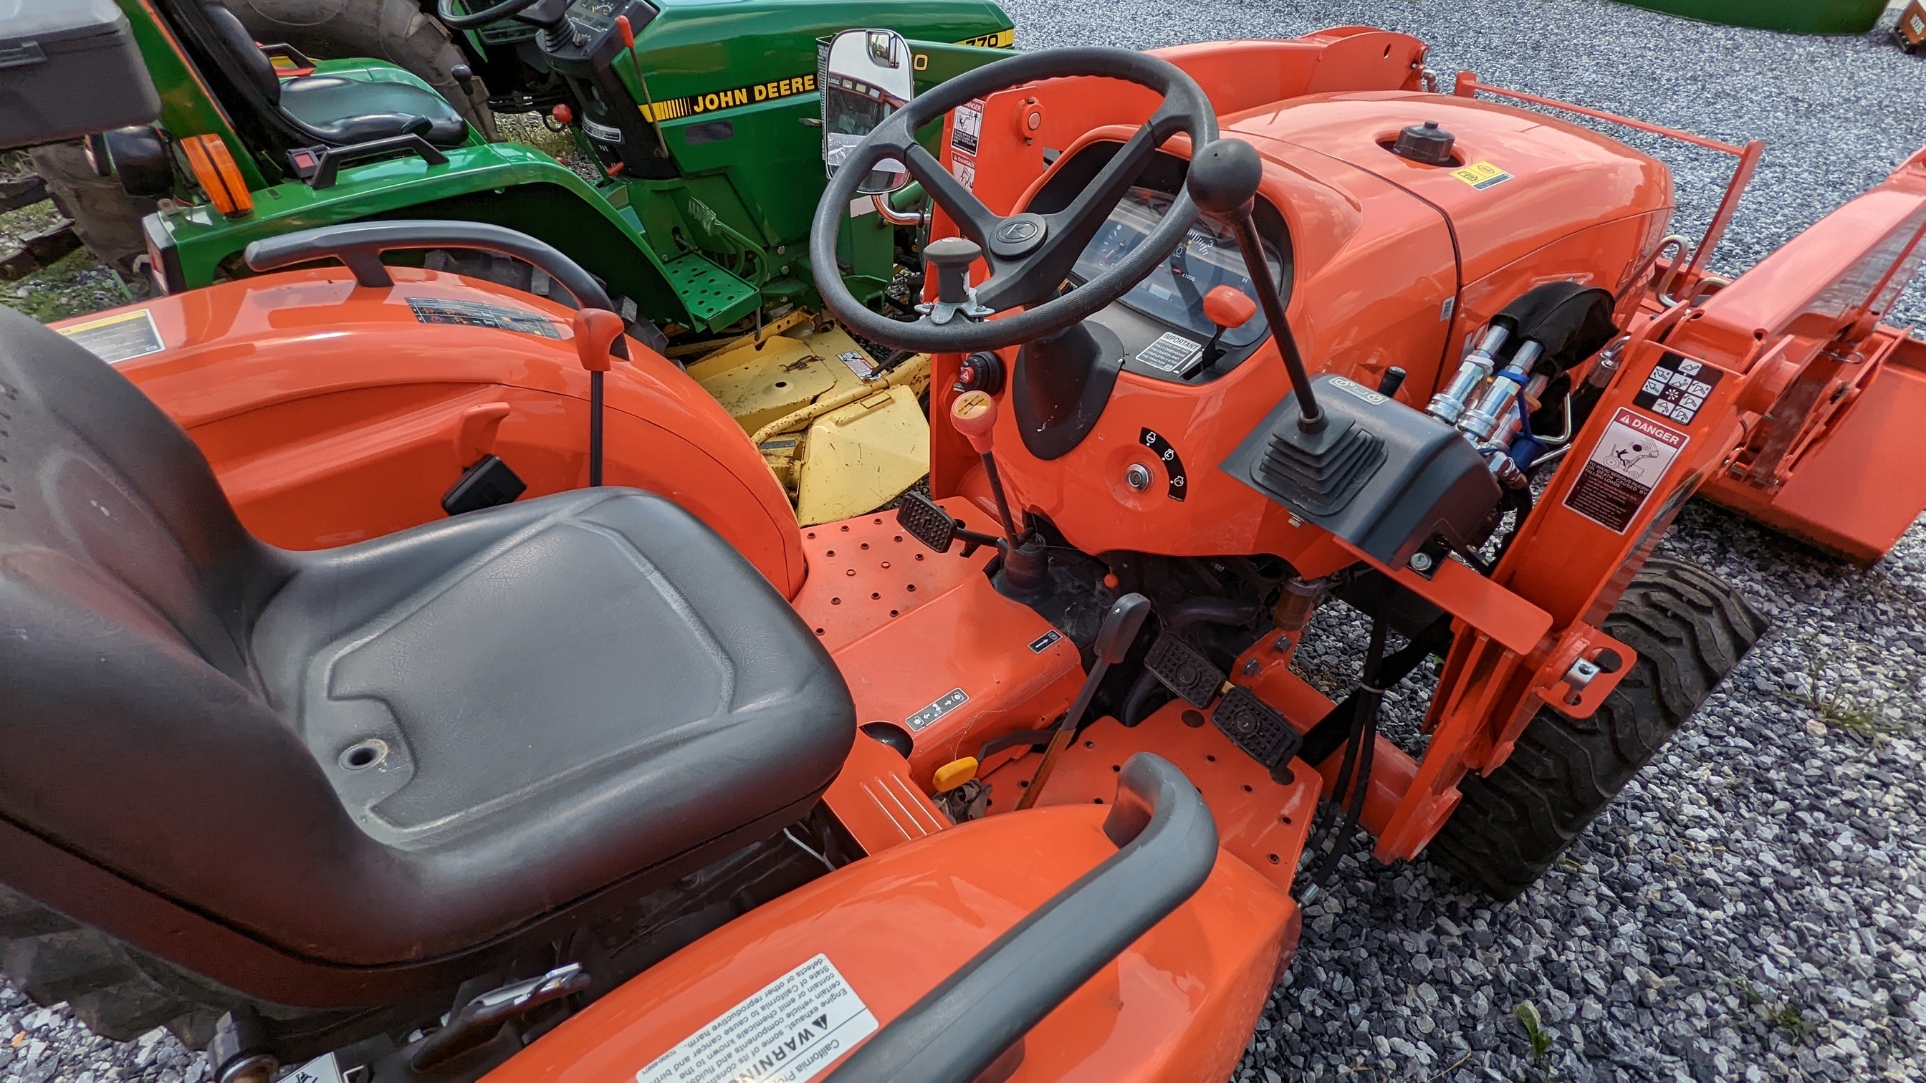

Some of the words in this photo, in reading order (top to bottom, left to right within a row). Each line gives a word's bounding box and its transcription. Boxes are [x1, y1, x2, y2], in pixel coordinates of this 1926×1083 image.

[693, 88, 748, 113] JOHN
[753, 74, 815, 101] DEERE
[1163, 333, 1199, 350] IMPORTANT
[1631, 418, 1680, 445] DANGER
[1585, 468, 1604, 479] FALLING
[1596, 465, 1610, 473] AVOID
[1611, 471, 1631, 483] SERIOUS
[1597, 469, 1613, 479] DEATH
[1616, 478, 1637, 491] CAUSED
[796, 959, 823, 977] defects
[809, 966, 829, 979] State
[765, 982, 784, 997] other
[800, 979, 807, 987] of
[807, 973, 834, 992] contain
[815, 981, 840, 999] certain
[760, 985, 798, 1011] California
[798, 991, 806, 999] or
[820, 988, 847, 1007] Engine
[712, 996, 762, 1031] reproductive
[778, 998, 796, 1012] emit
[786, 998, 814, 1018] vehicle
[724, 1017, 748, 1035] cause
[736, 1010, 777, 1039] chemicals
[785, 1006, 818, 1030] exhaust,
[685, 1030, 710, 1047] harm.
[734, 1017, 784, 1053] components
[762, 1030, 784, 1047] some
[693, 1035, 722, 1057] cancer
[707, 1039, 735, 1060] known
[751, 1047, 760, 1056] of
[674, 1056, 690, 1071] and
[696, 1059, 705, 1067] to
[716, 1052, 732, 1068] and
[738, 1054, 749, 1064] its
[795, 1039, 839, 1072] California
[679, 1067, 694, 1079] the
